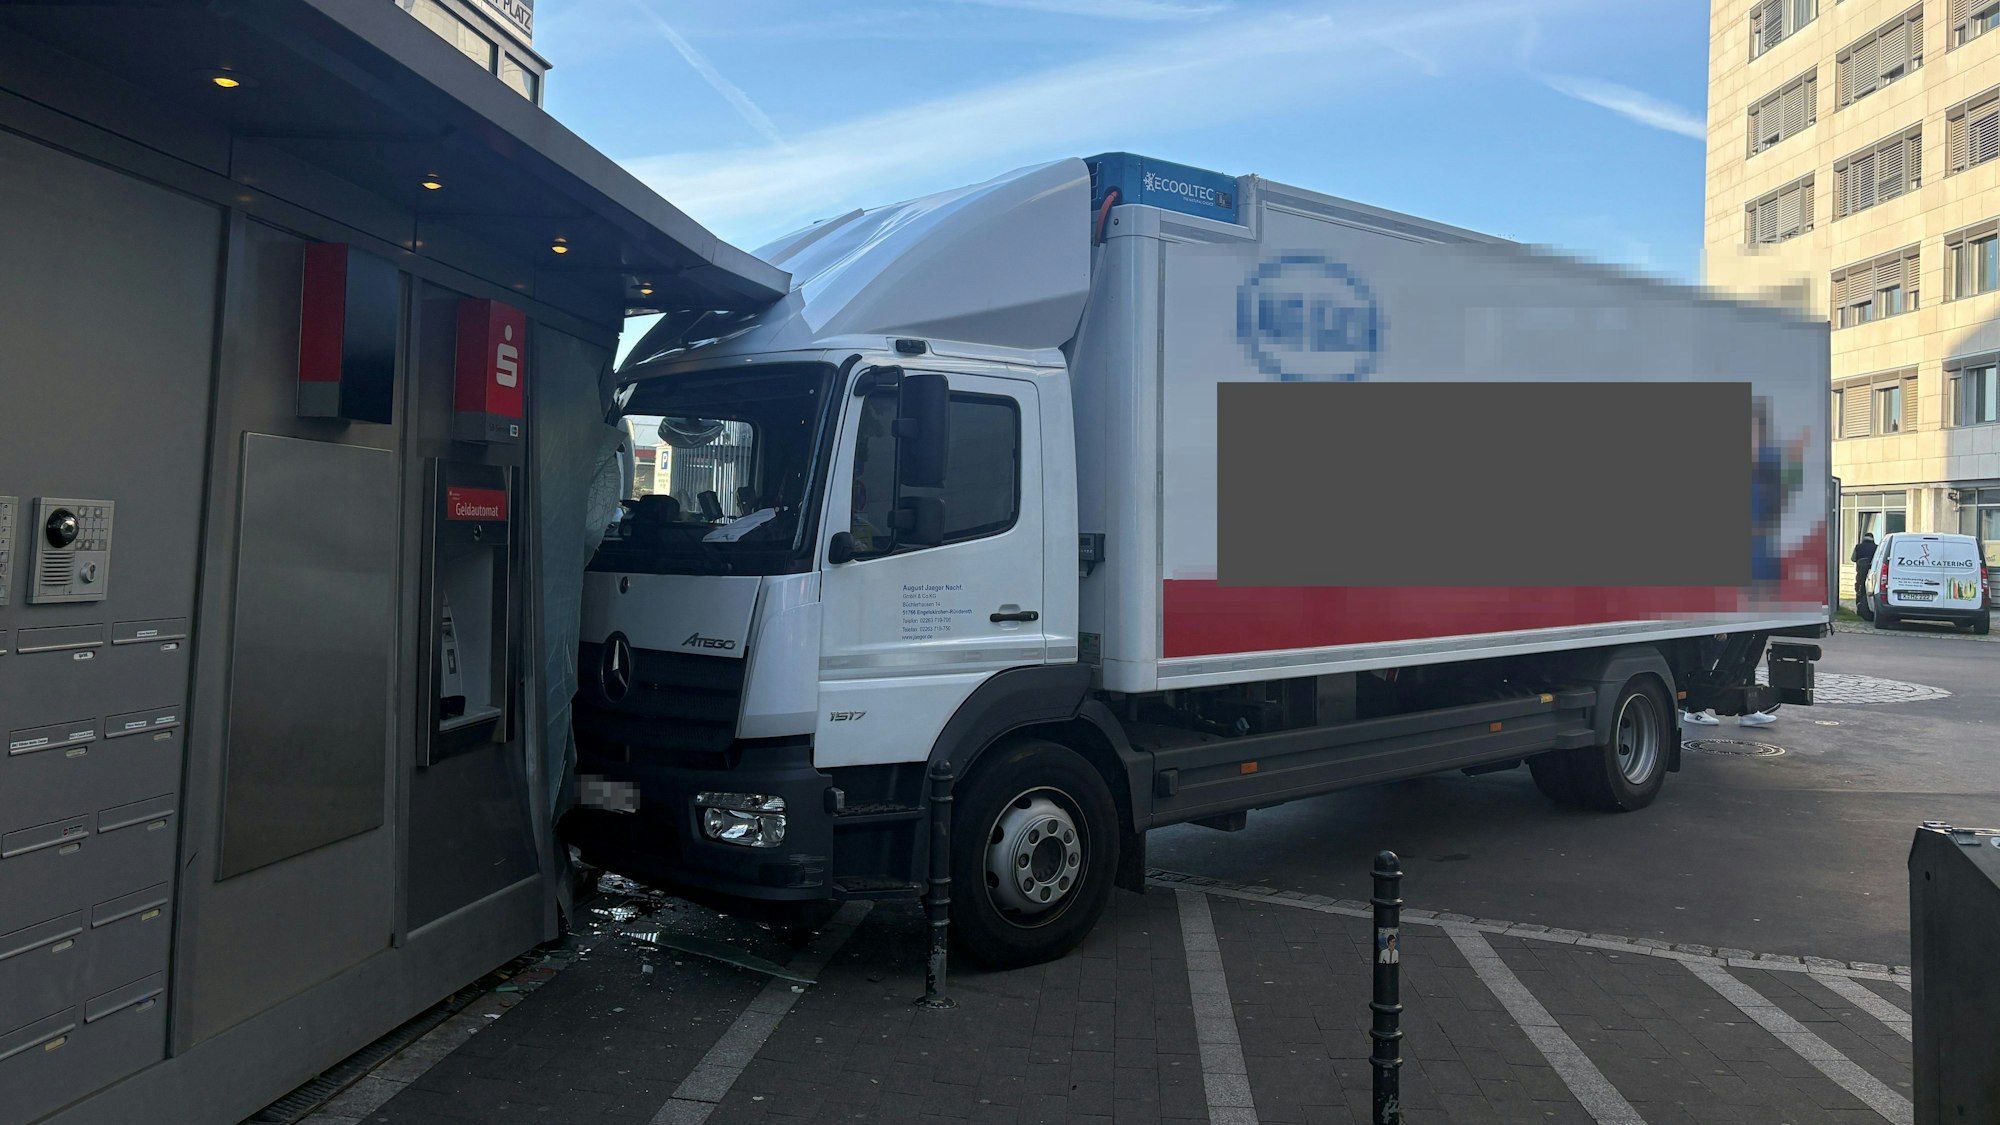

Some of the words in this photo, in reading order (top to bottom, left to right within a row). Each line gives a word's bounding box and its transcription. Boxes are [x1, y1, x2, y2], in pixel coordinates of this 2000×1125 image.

[504, 0, 531, 30] PLATZ
[1155, 177, 1214, 201] ECOOLTEC
[662, 453, 668, 468] P
[455, 502, 499, 517] Geldautomat
[1898, 557, 1924, 566] ZOCH
[925, 584, 944, 592] Jaeger
[681, 632, 736, 650] ATEGO
[829, 710, 867, 722] 1517
